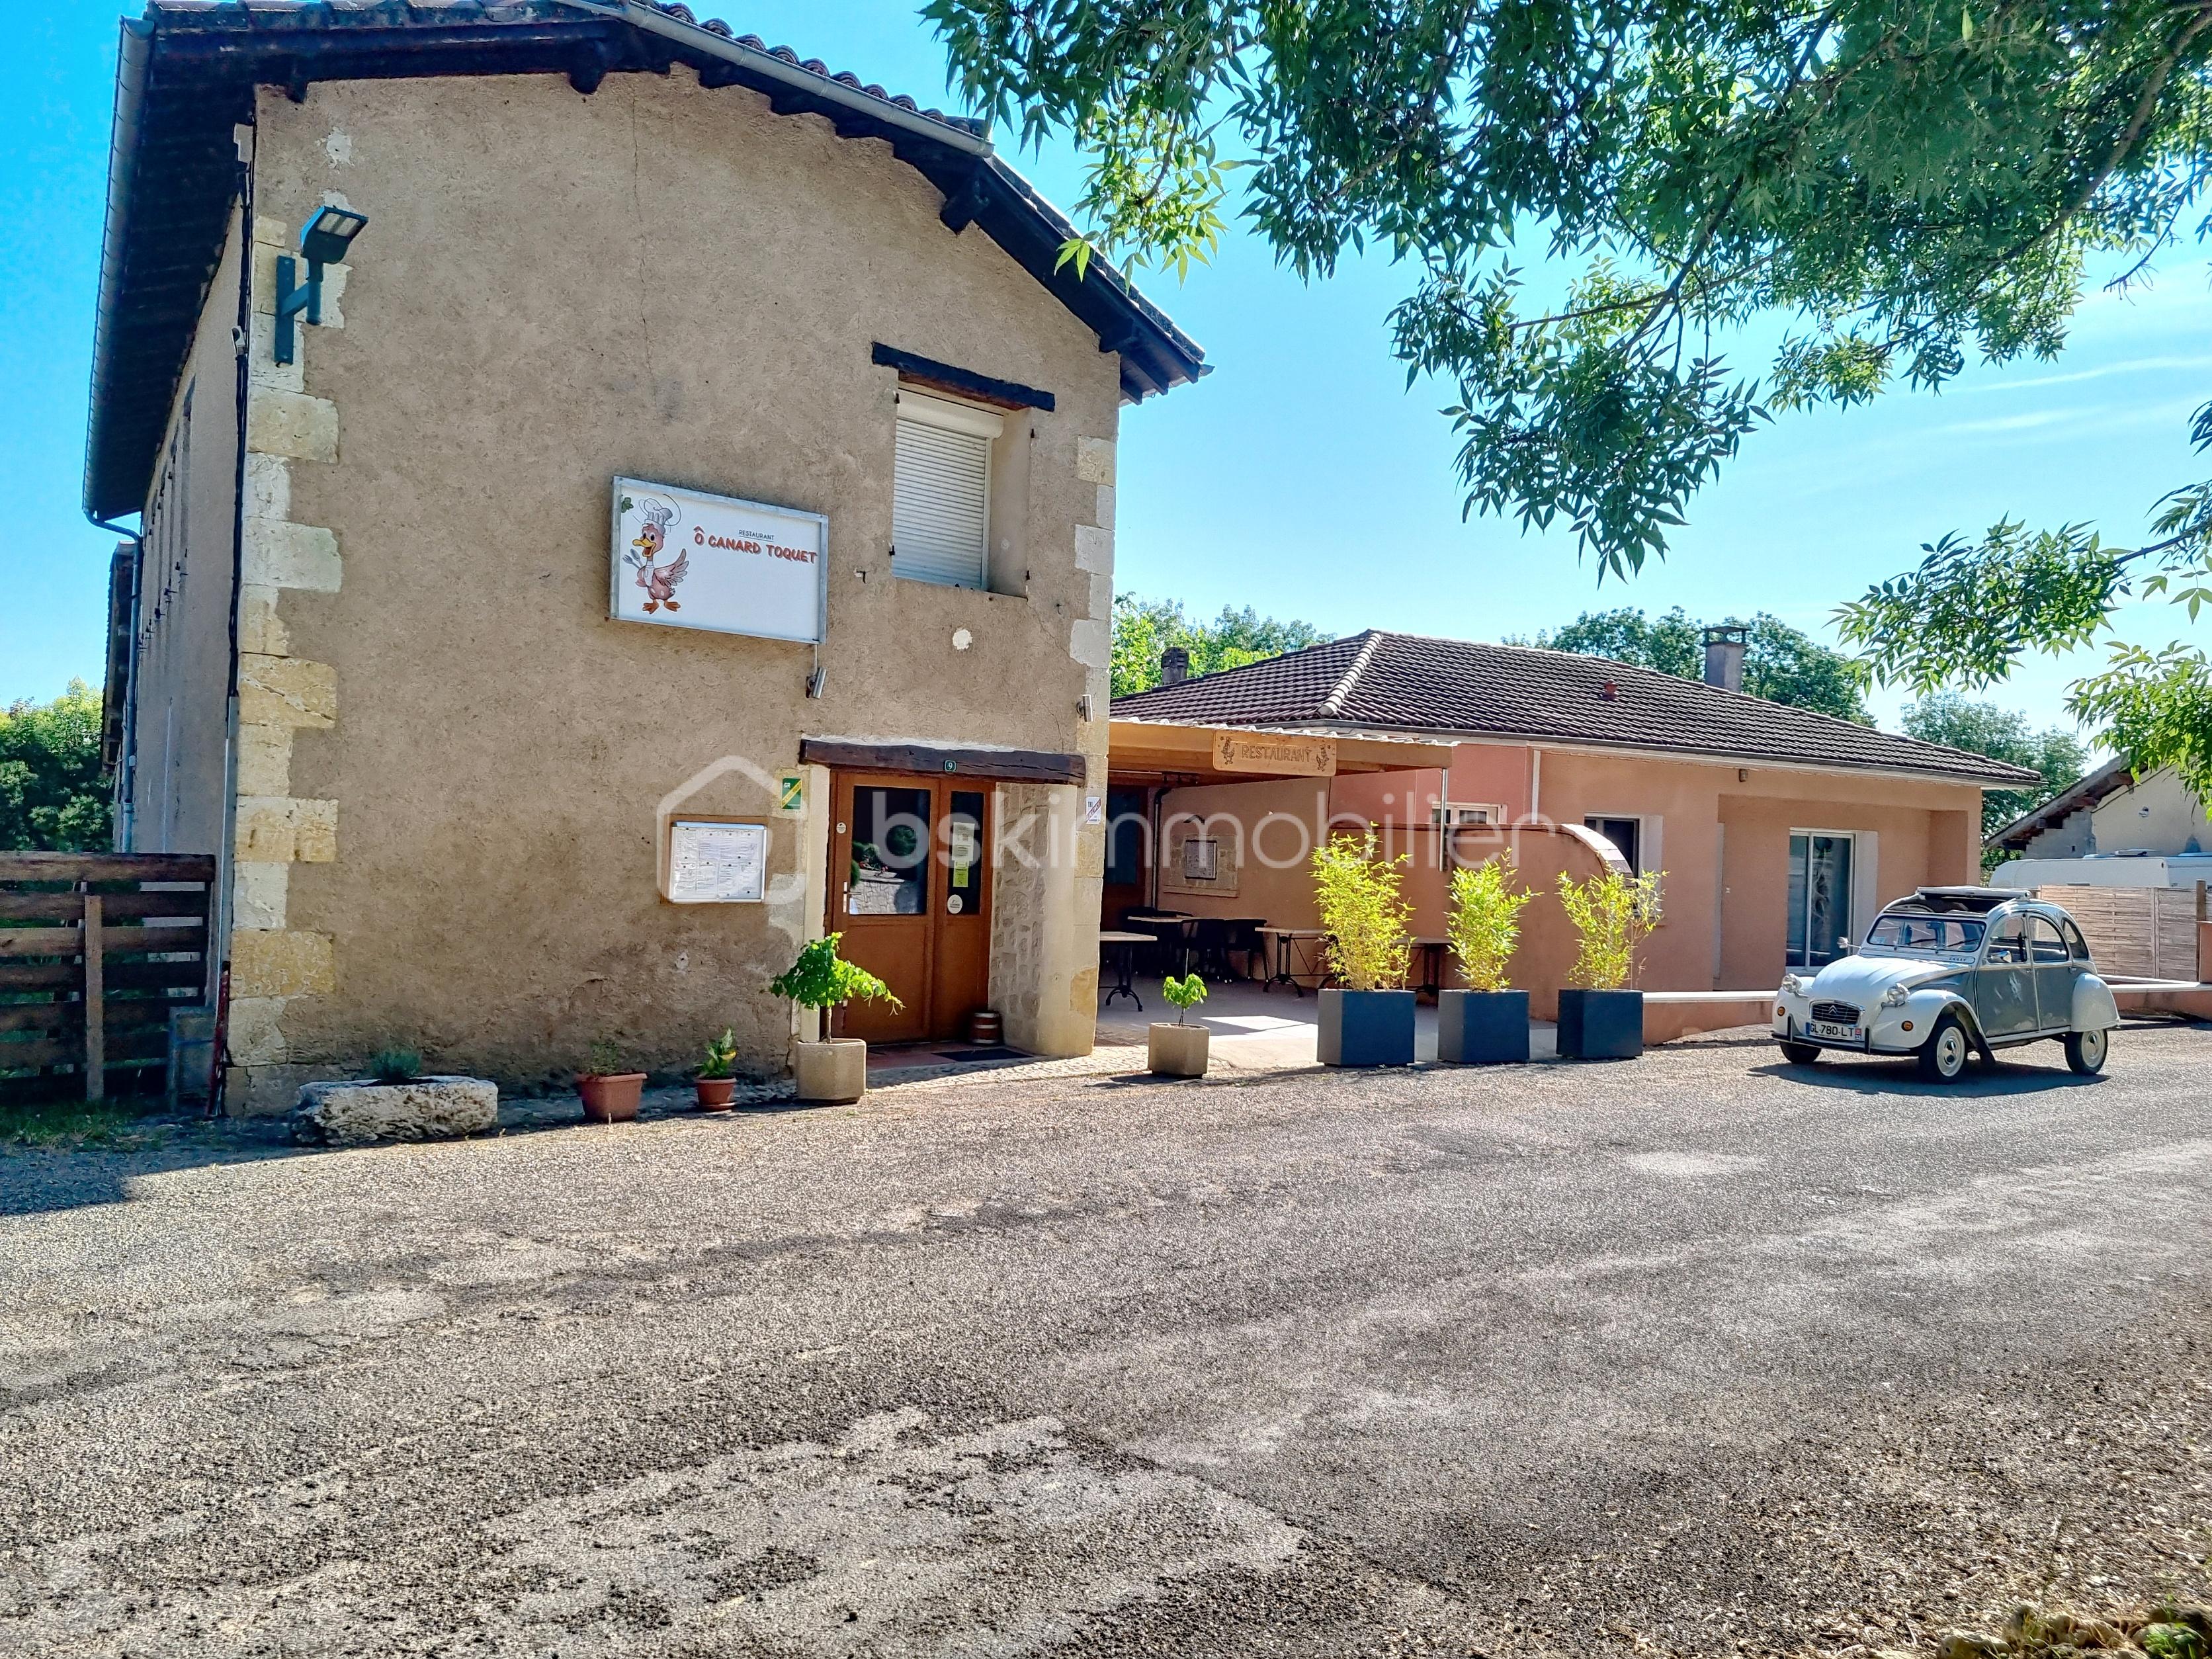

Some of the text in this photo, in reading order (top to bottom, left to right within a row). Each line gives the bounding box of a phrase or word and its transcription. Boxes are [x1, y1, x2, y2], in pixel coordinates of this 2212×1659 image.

[739, 529, 775, 540] RESTAURANT
[693, 526, 818, 564] Ô CANARD TOQUET
[1242, 745, 1312, 762] RESTAURANT
